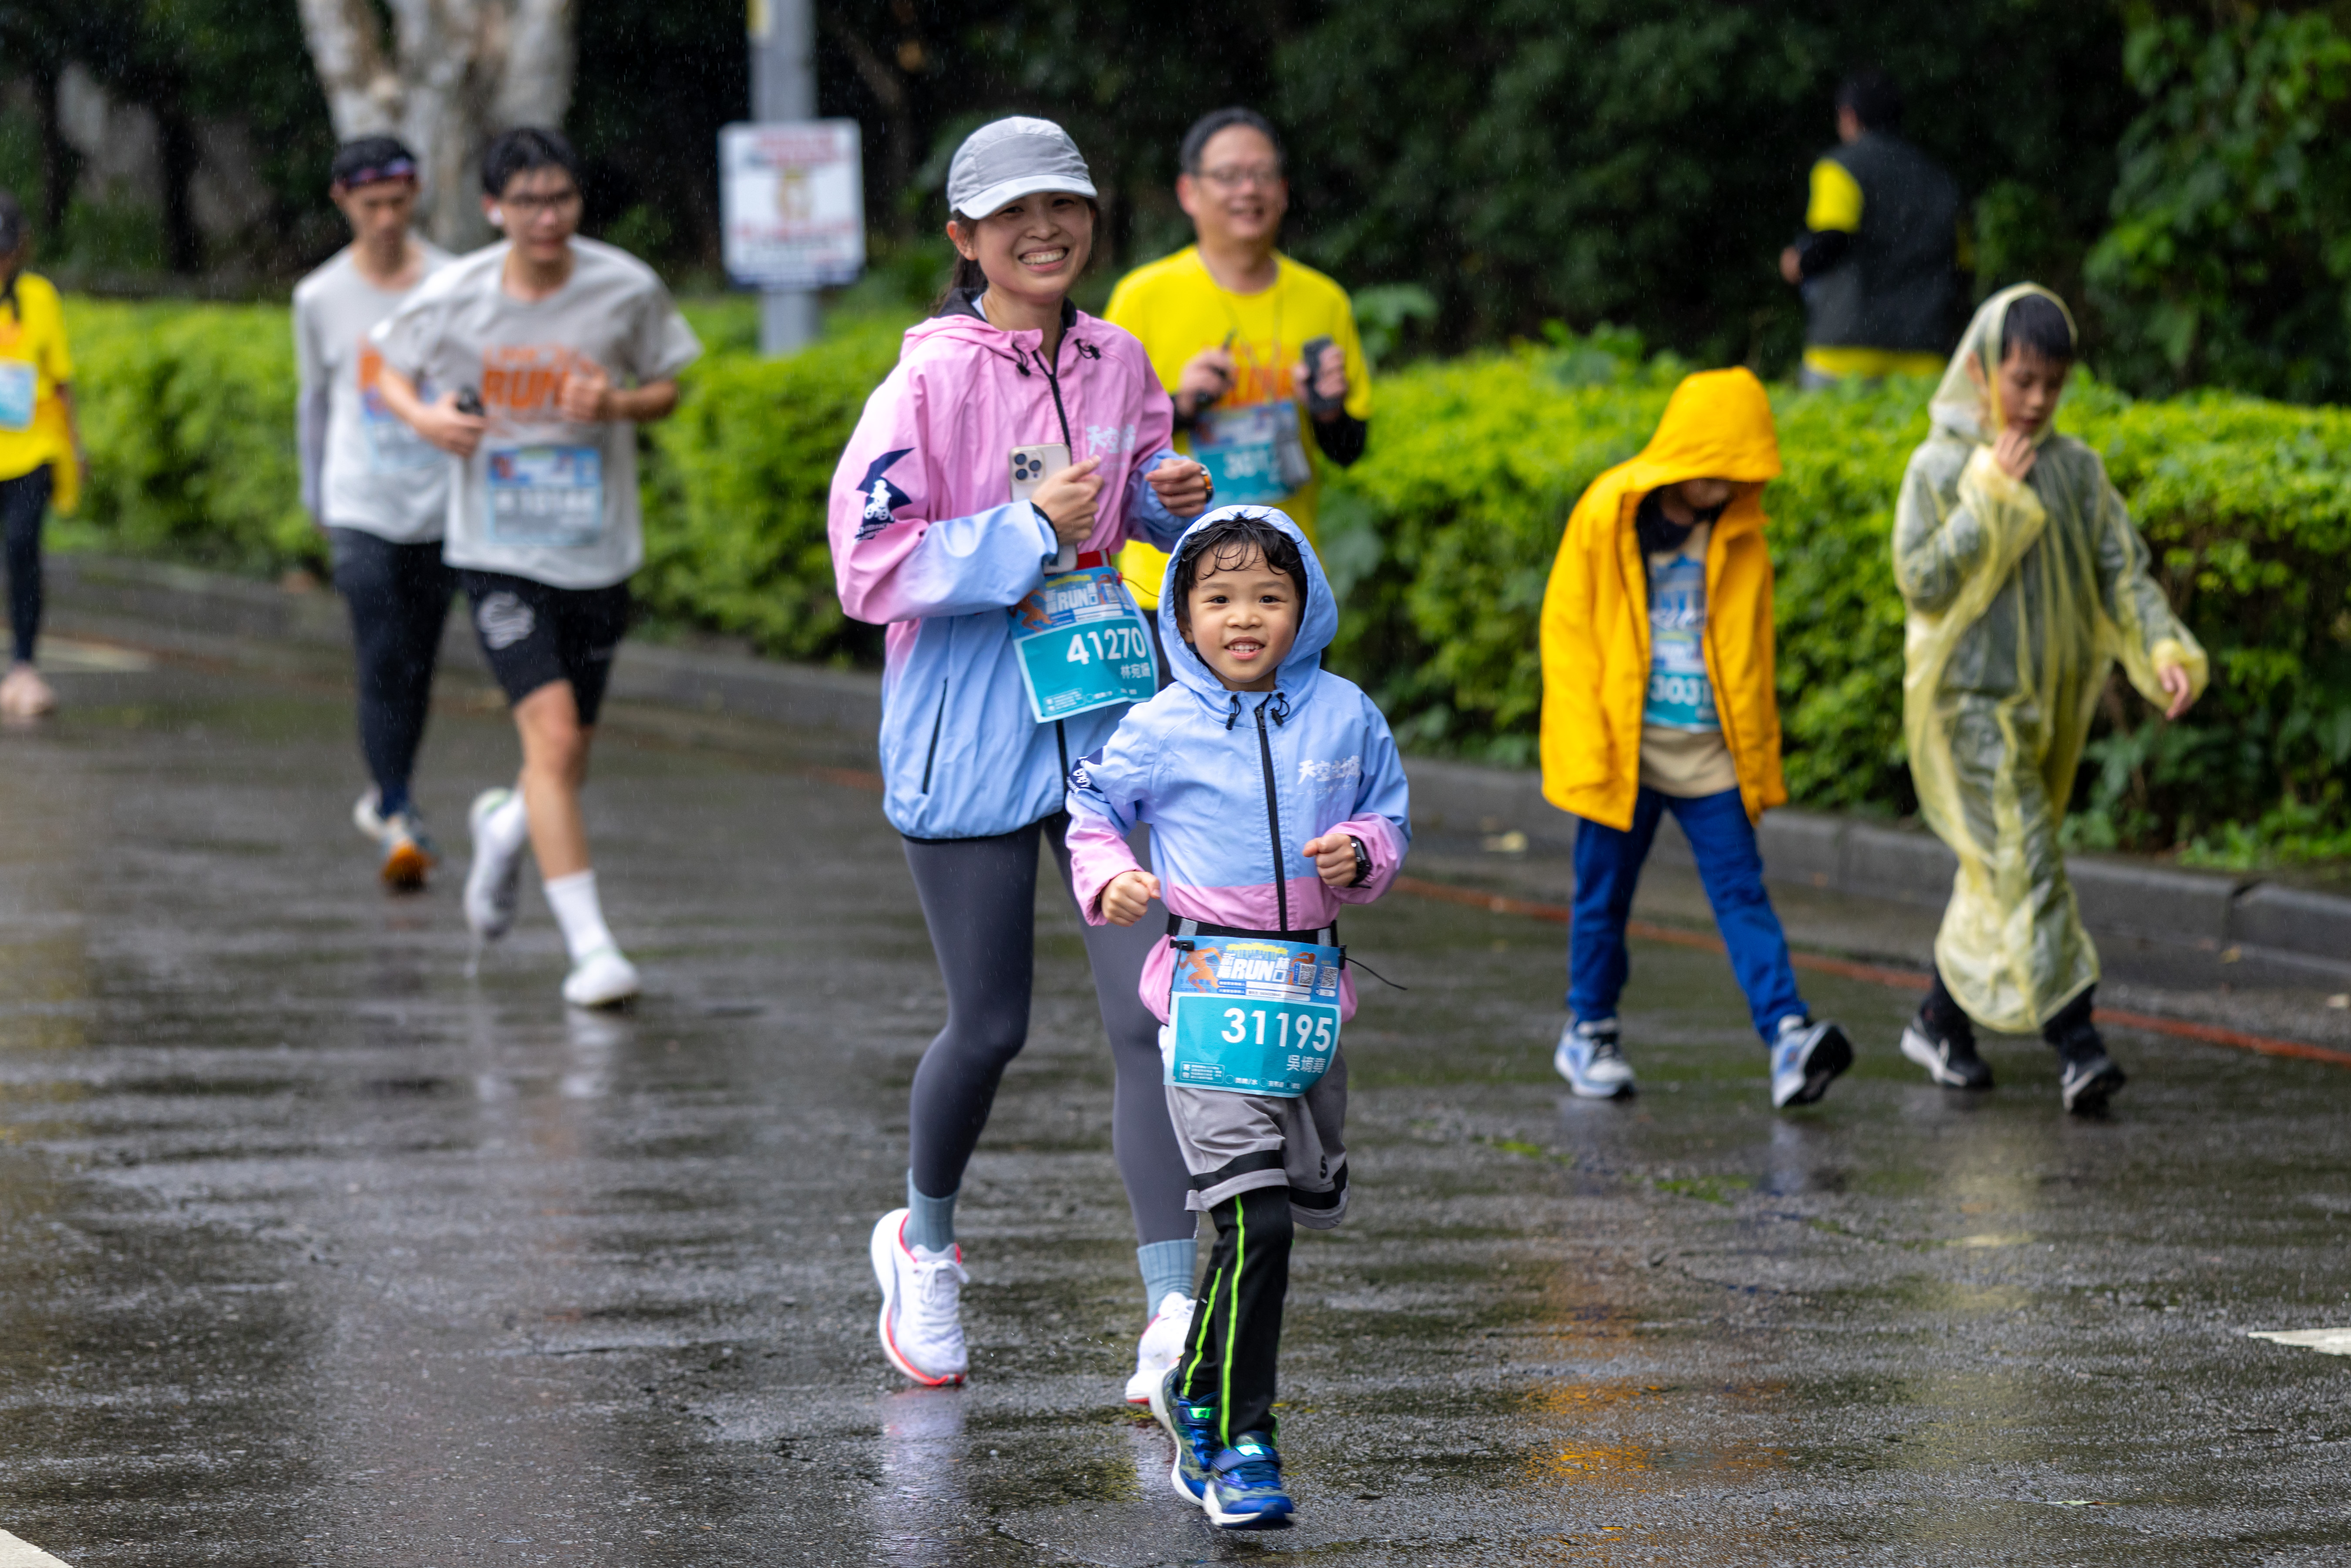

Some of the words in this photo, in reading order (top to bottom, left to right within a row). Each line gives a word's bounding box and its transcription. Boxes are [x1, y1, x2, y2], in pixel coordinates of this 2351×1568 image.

[1057, 588, 1088, 611] RUN
[1066, 627, 1147, 665] 41270
[1230, 958, 1276, 981] RUN
[1221, 1008, 1333, 1052] 31195
